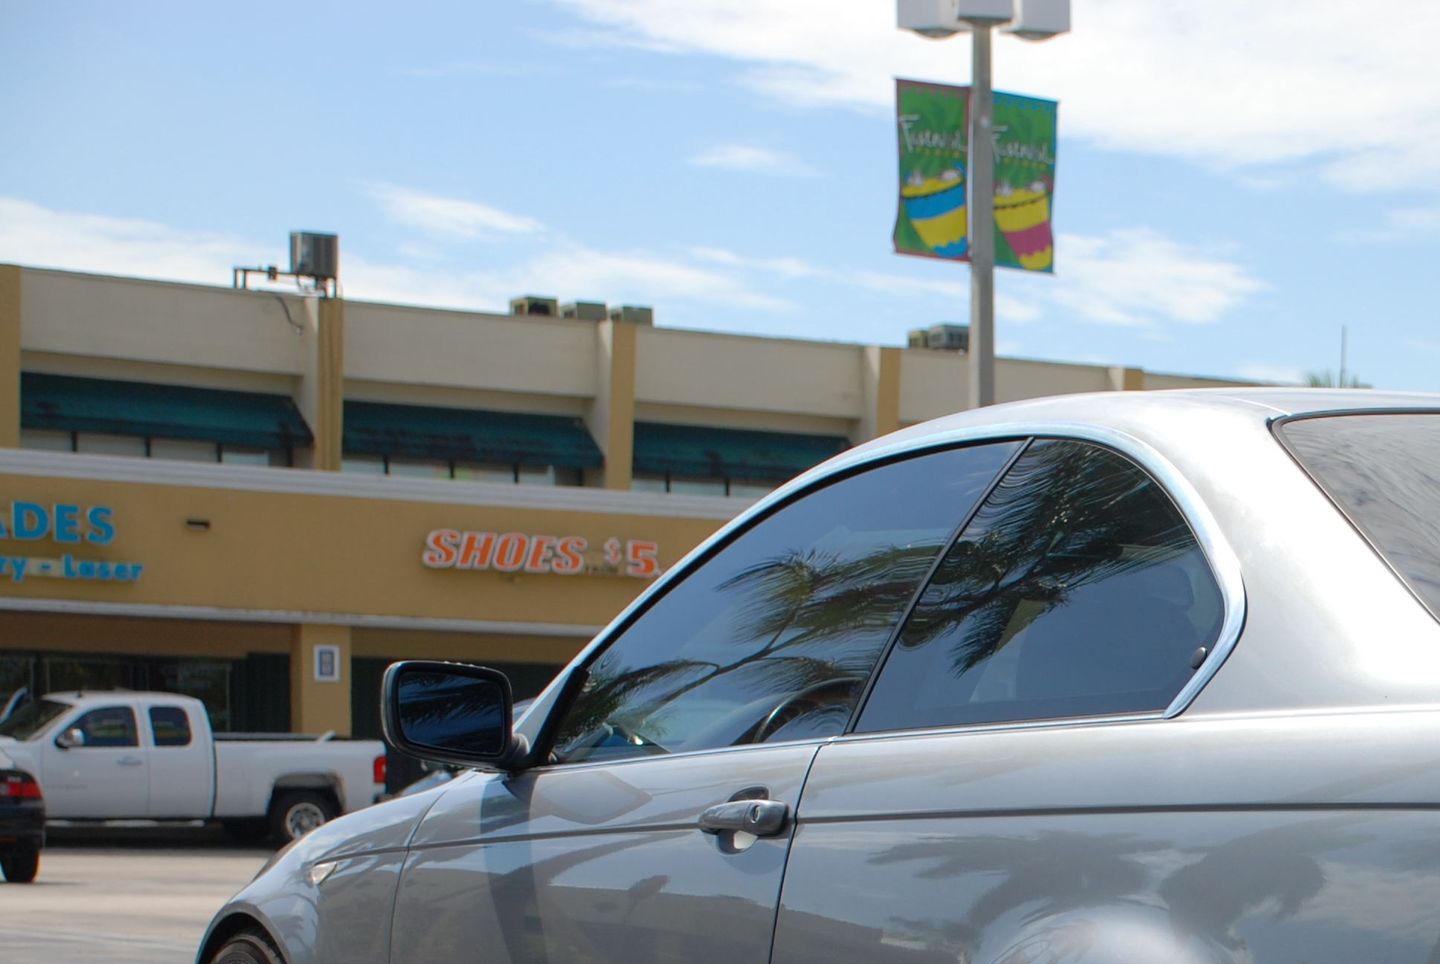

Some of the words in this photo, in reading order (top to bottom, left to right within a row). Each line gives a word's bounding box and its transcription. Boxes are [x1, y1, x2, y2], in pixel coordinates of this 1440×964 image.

[0, 500, 116, 545] DES
[63, 553, 143, 581] Laser
[423, 529, 587, 575] SHOES
